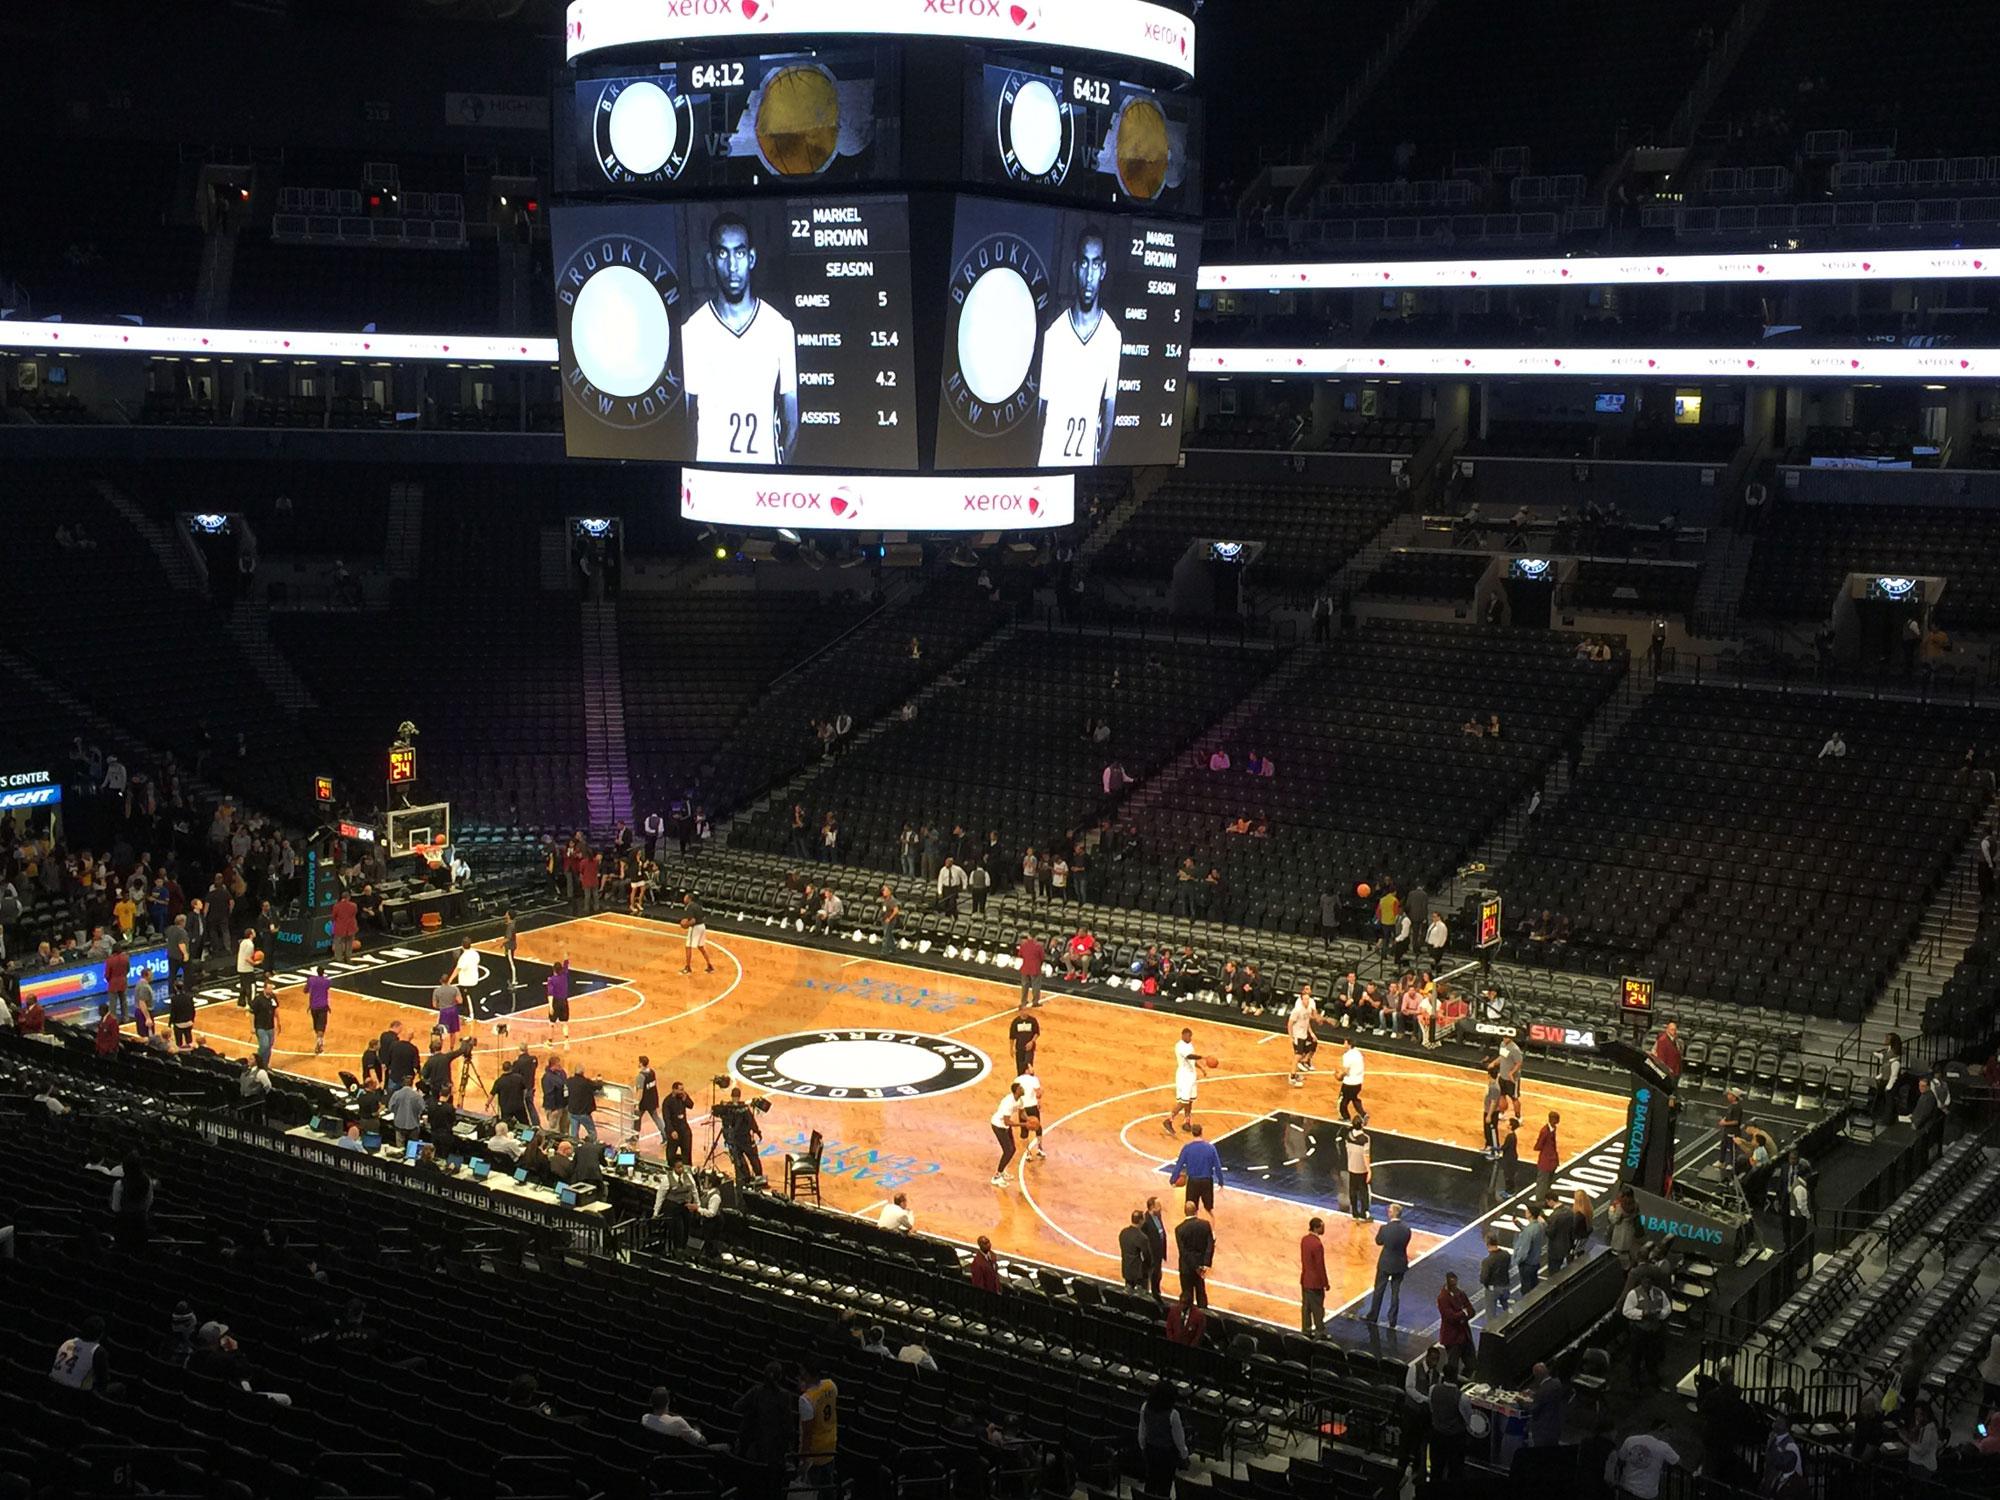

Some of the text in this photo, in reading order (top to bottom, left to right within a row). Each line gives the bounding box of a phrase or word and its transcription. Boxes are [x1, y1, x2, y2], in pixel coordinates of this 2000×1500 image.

[667, 0, 732, 17] xerox
[924, 0, 1000, 17] xerox
[1144, 21, 1178, 44] xerox
[692, 63, 745, 88] 64:12
[601, 77, 686, 113] BRLYN
[1073, 77, 1110, 105] 64:12
[644, 153, 684, 182] ORK
[792, 208, 861, 237] 22 MARKEL
[814, 229, 868, 247] BROWN
[1131, 231, 1175, 256] 22 MARKEL
[826, 262, 874, 277] SEASON
[1144, 251, 1177, 269] BROWN
[559, 243, 681, 306] BROOKLYN
[951, 241, 1049, 311] BROOKLYN
[1147, 280, 1176, 295] SEASON
[795, 291, 888, 307] GAMES 5
[1125, 308, 1180, 323] GAMES 5
[797, 331, 899, 347] MINUTES 15.4
[799, 371, 896, 386] POINTS 4.2
[1118, 380, 1141, 391] POINTS
[569, 367, 681, 420] NEW YORK
[947, 371, 1038, 426] NEW YORK
[801, 410, 898, 426] ASSISTS 1.4
[729, 412, 758, 454] 22
[1063, 417, 1087, 457] 22
[756, 489, 821, 510] xerox
[963, 493, 1023, 512] xerox
[10, 771, 50, 786] CENTER
[393, 762, 410, 779] 24
[277, 930, 303, 944] RCLAYS
[1483, 918, 1496, 940] 24
[147, 958, 169, 975] big
[1625, 980, 1650, 993] 64:11
[1629, 994, 1646, 1005] 24
[1476, 1023, 1517, 1037] GEICO
[1530, 1023, 1595, 1048] SW24
[819, 1030, 979, 1070] NEW YORK
[742, 1053, 920, 1098] BROOKLYN
[1626, 1103, 1649, 1169] BARCLAYS
[1648, 1216, 1723, 1245] BARCLAYS
